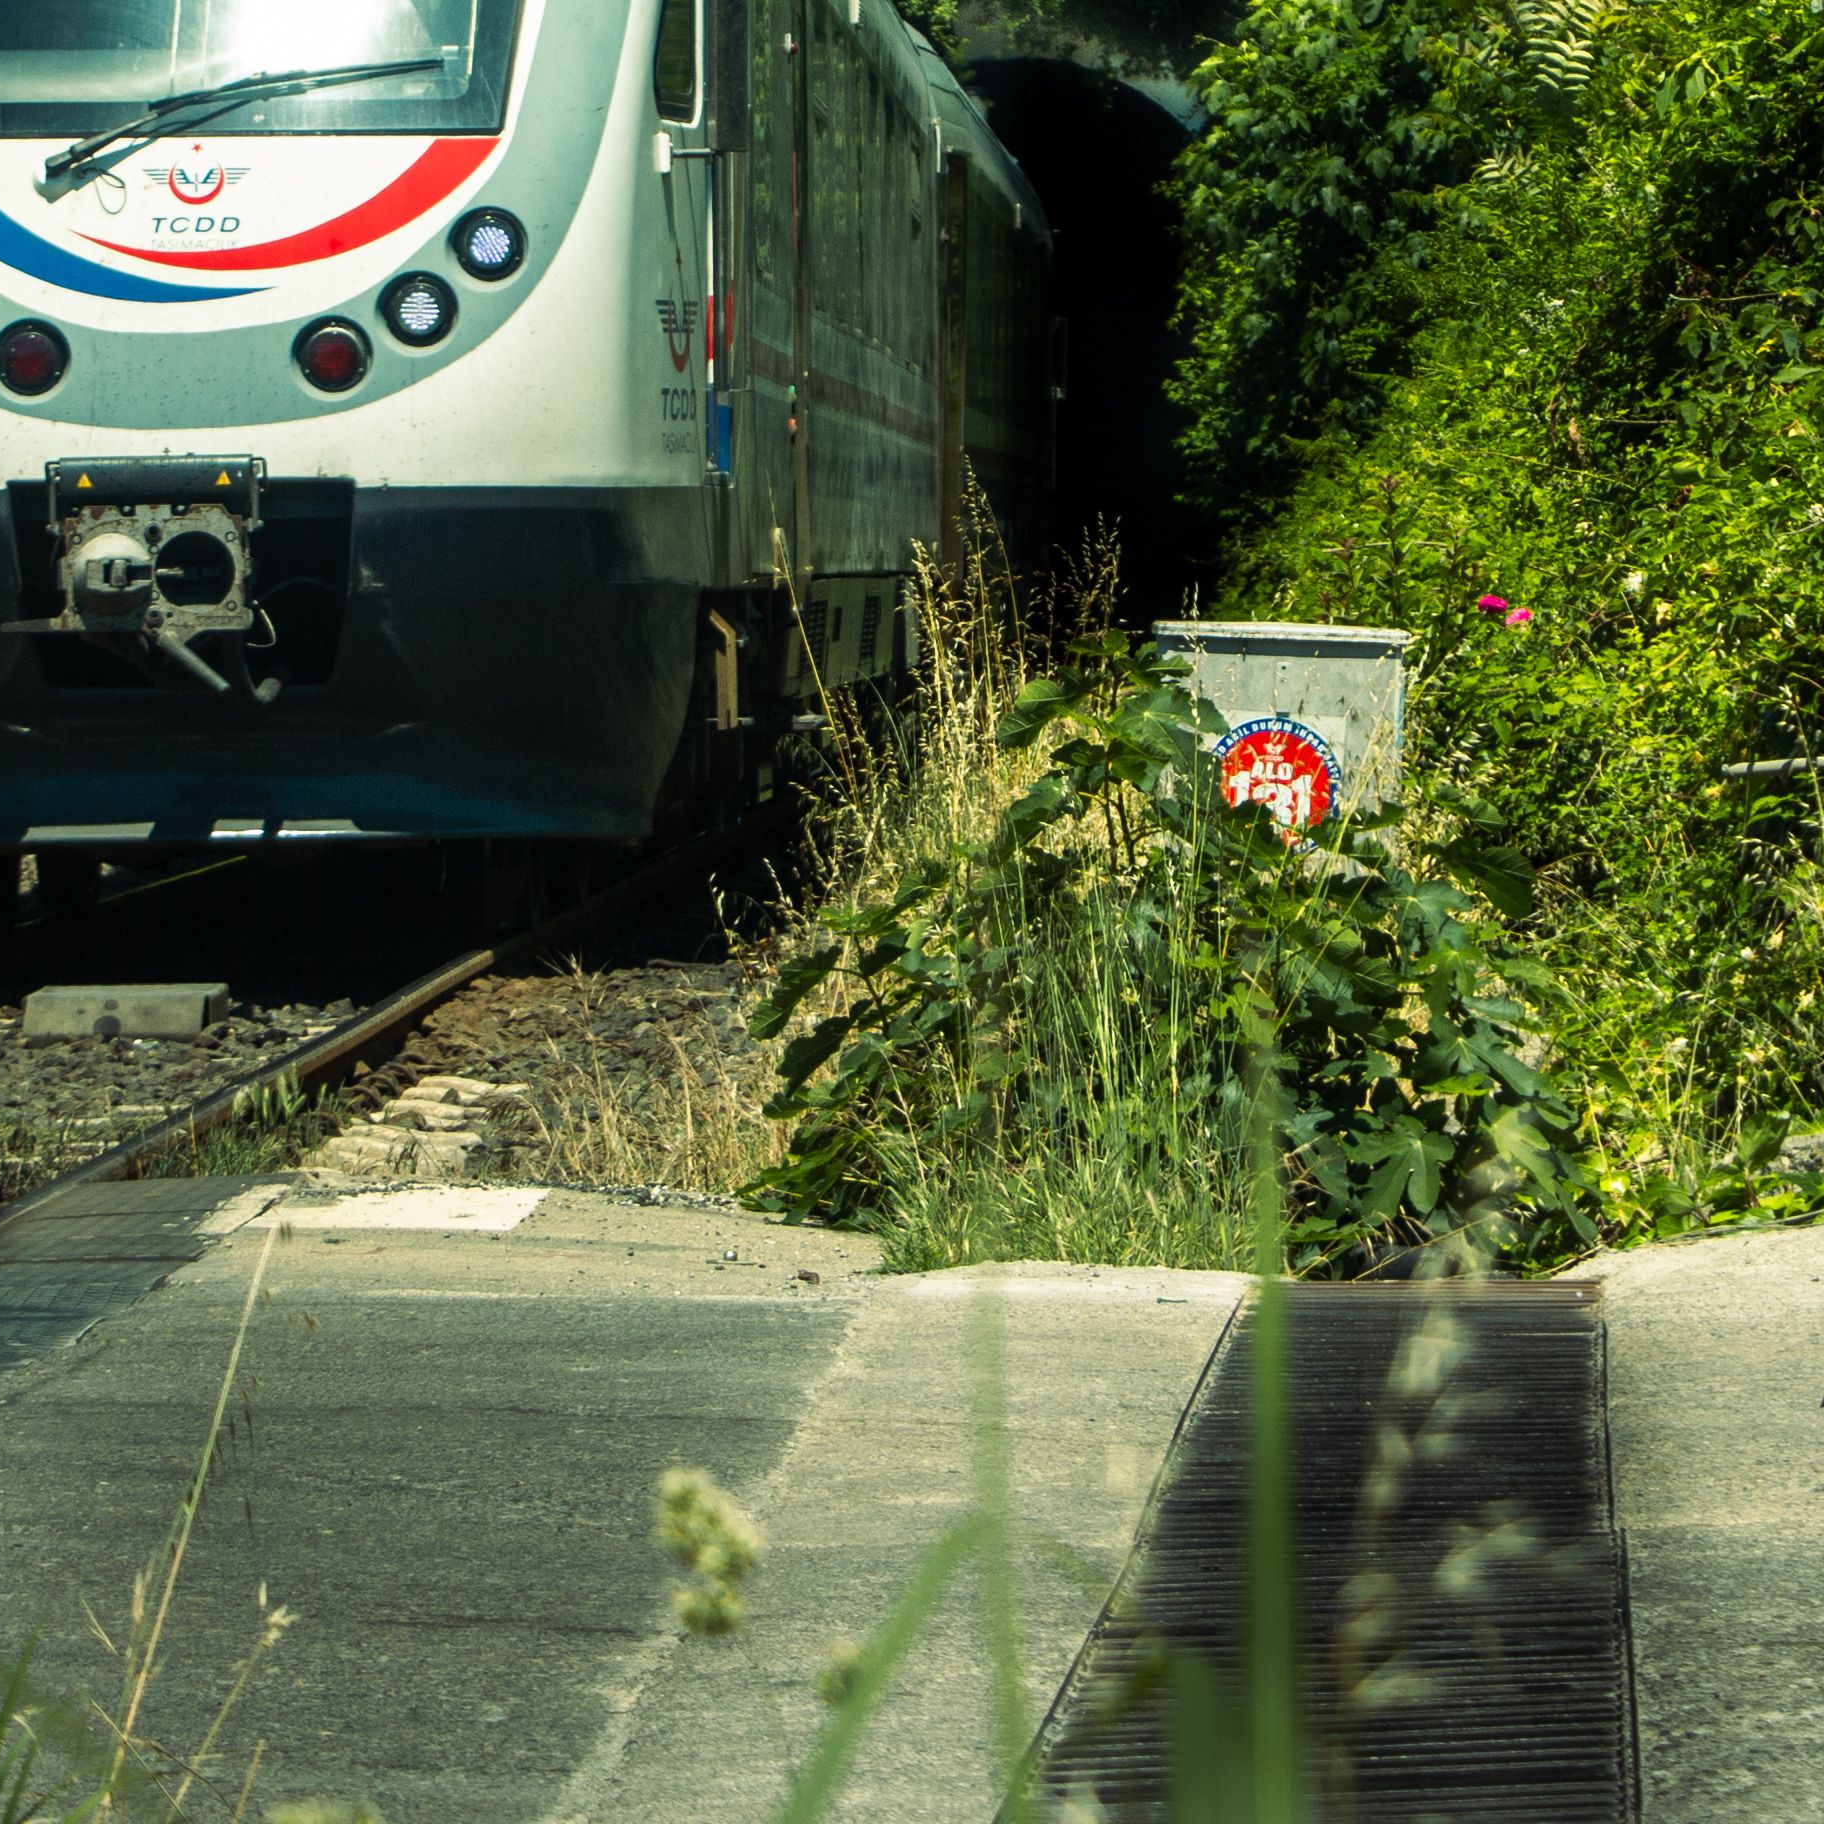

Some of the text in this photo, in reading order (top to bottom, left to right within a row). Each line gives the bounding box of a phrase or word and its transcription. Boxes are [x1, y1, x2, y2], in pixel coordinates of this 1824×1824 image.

[151, 217, 241, 234] TCDD
[661, 388, 697, 421] TCDD
[1250, 761, 1294, 781] ALO
